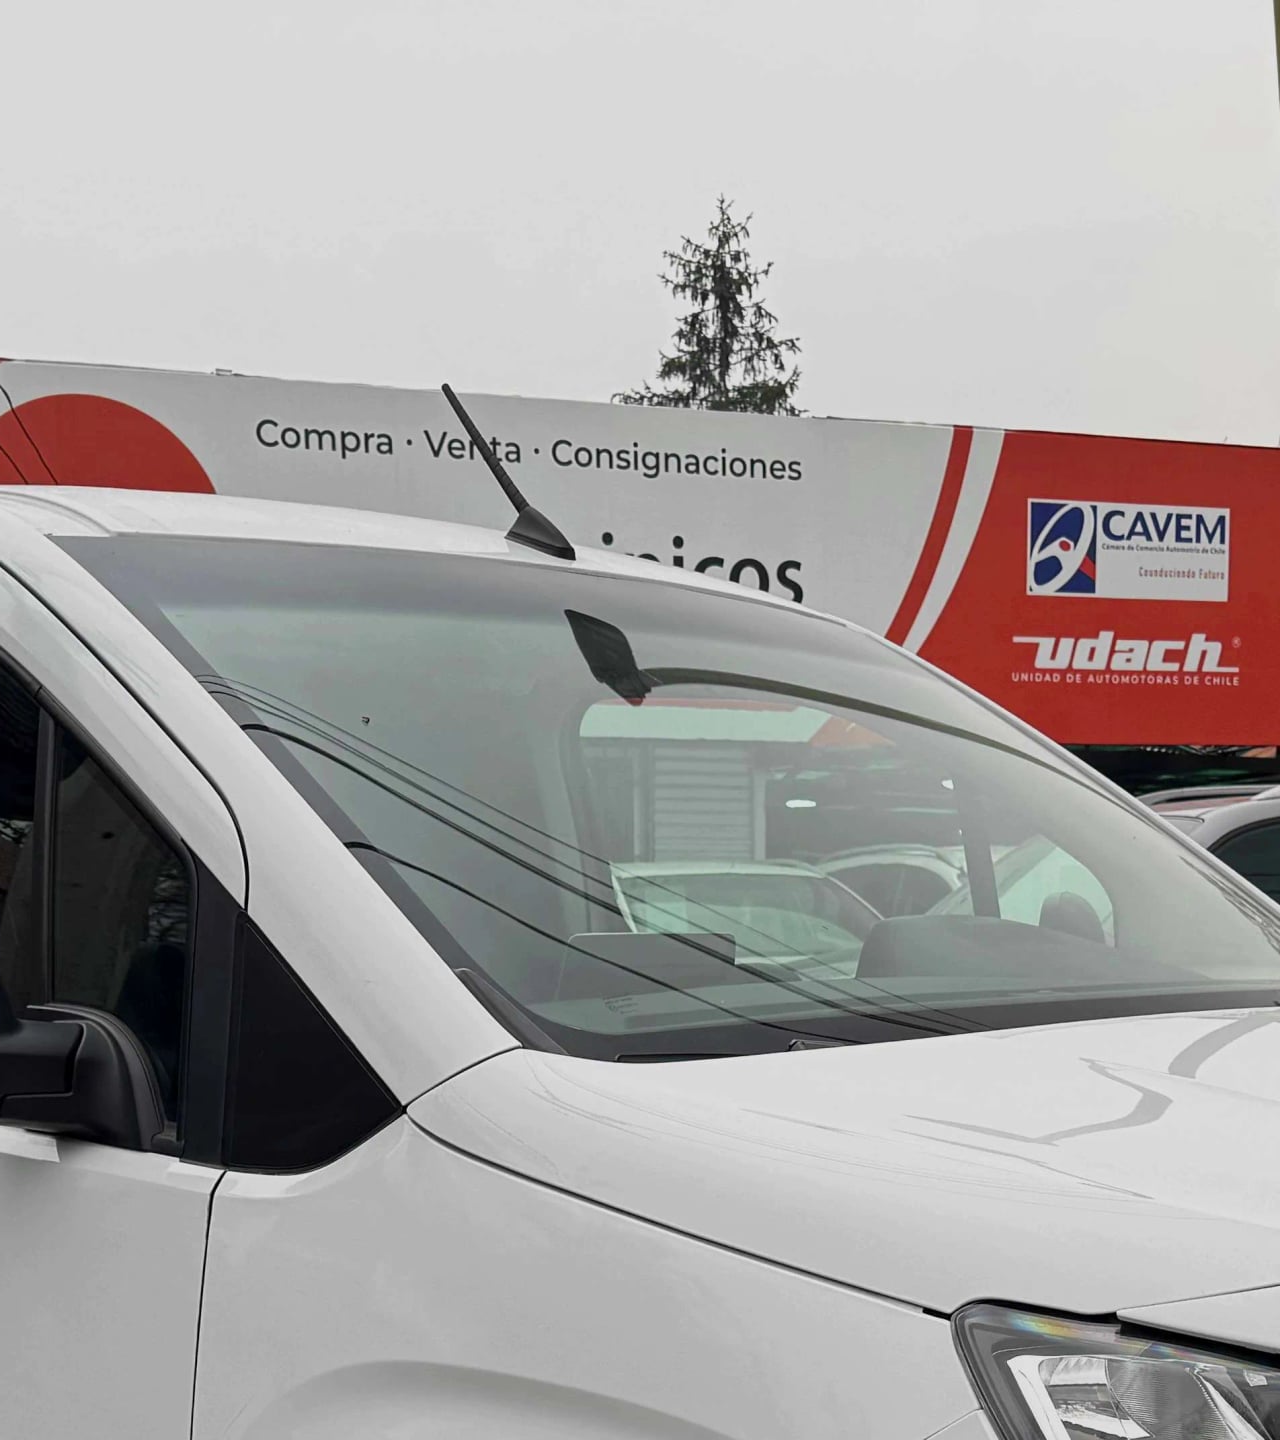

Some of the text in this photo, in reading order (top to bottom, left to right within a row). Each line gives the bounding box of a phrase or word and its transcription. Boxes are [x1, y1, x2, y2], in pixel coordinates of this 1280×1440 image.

[255, 418, 394, 460] Compra
[551, 438, 803, 482] Consignaciones
[1101, 509, 1227, 545] CAVEM
[1012, 630, 1240, 673] udach
[1011, 672, 1240, 687] UNIDAD DE AUTOMOTORAS DE CHILE
